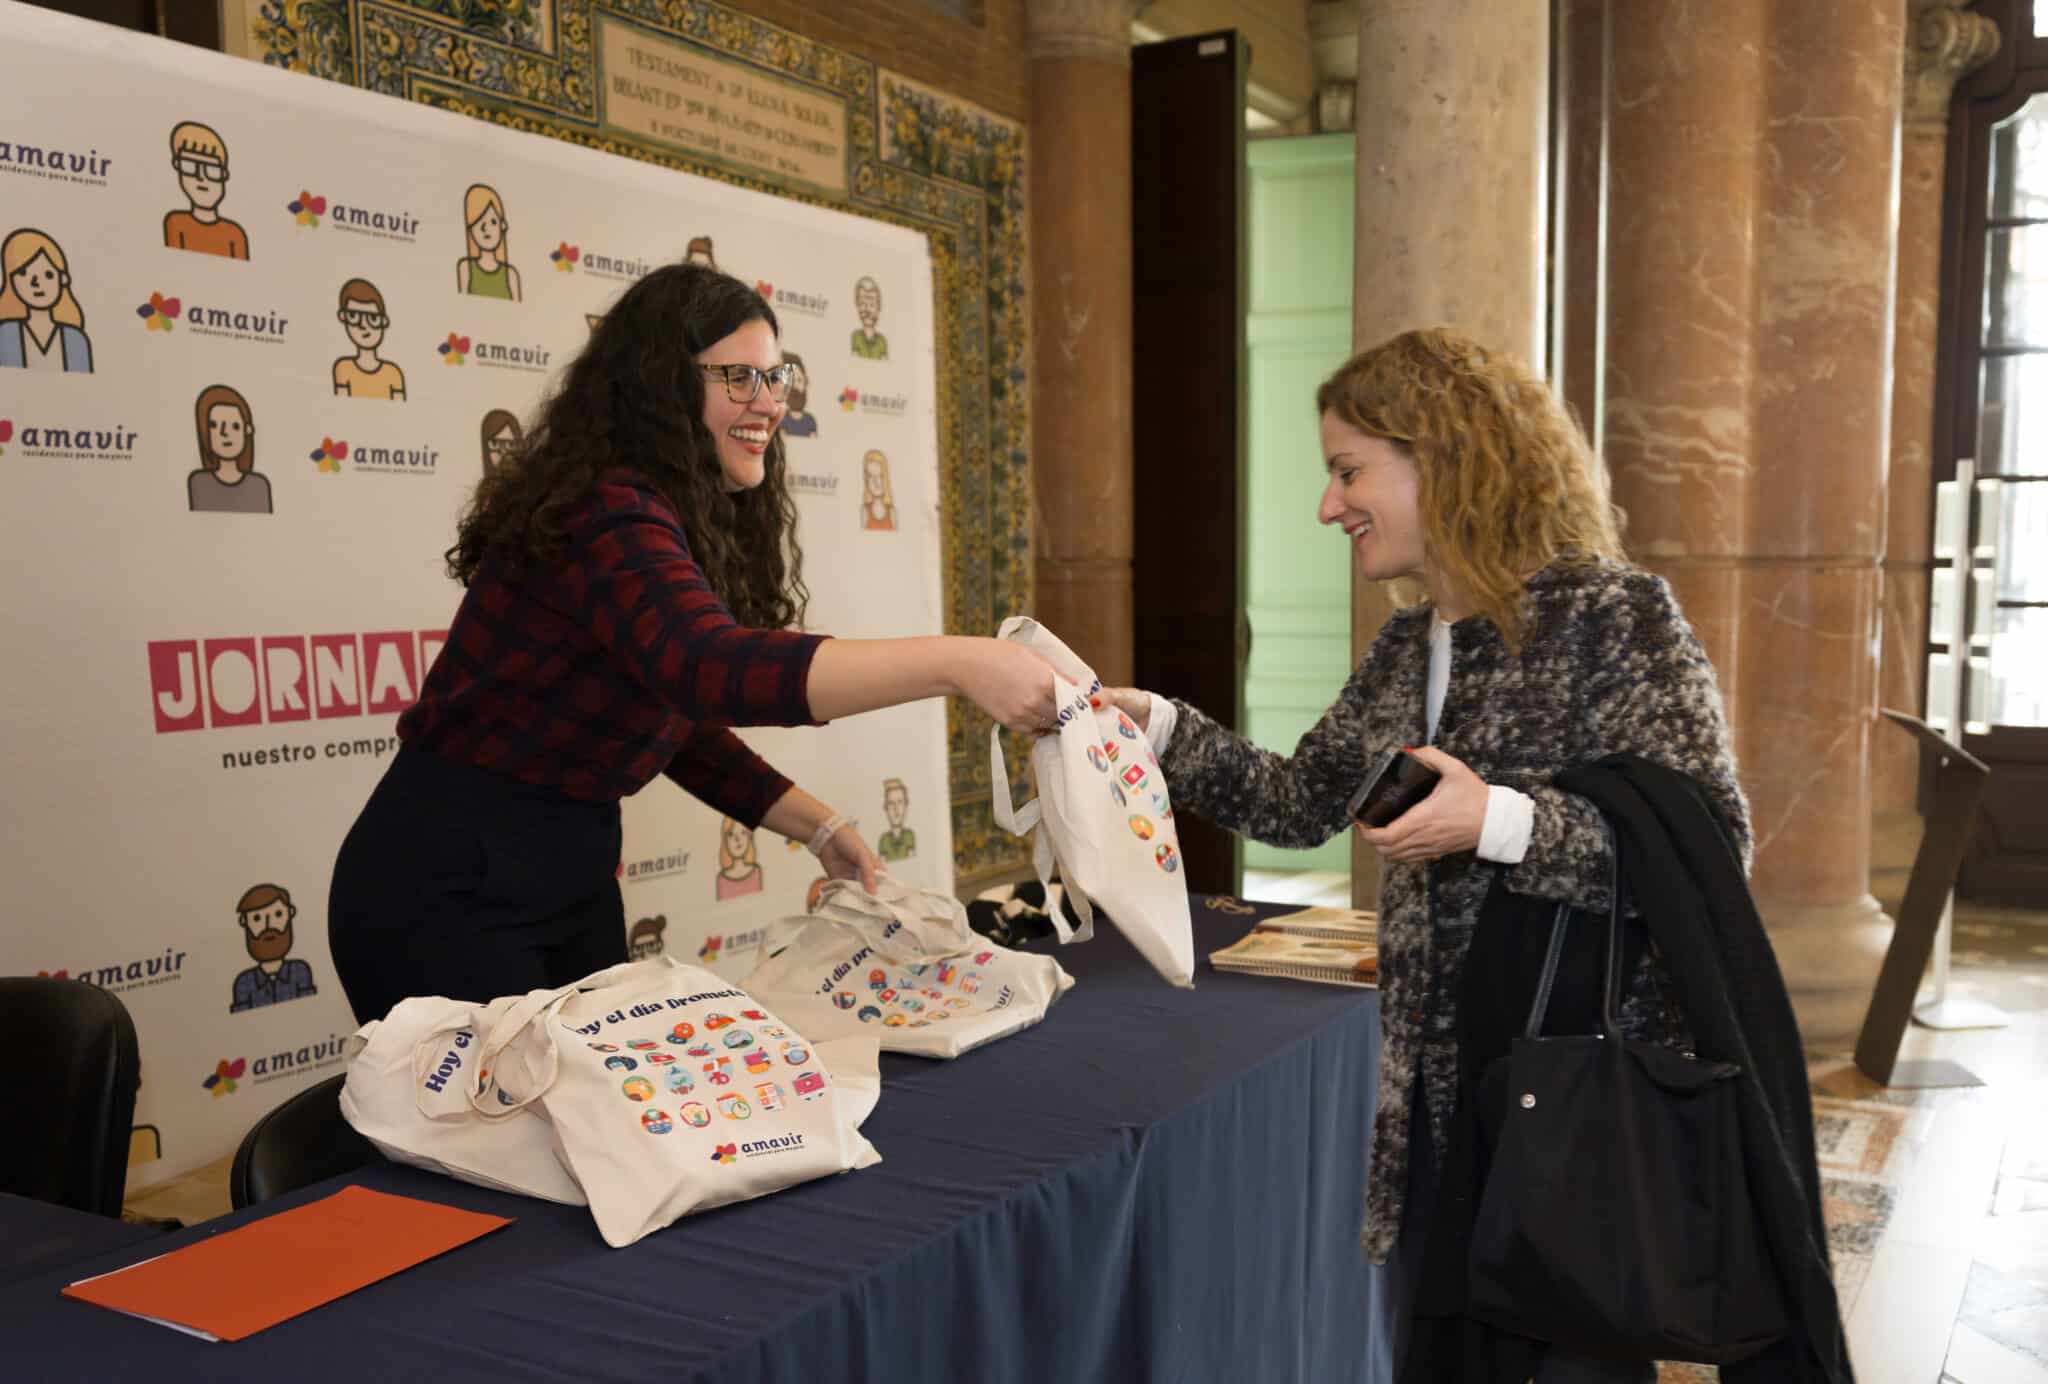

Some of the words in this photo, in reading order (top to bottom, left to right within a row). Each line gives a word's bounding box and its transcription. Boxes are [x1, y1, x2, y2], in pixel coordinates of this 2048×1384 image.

[0, 142, 112, 176] amavir
[332, 205, 419, 235] amavir
[584, 254, 651, 276] amavir
[776, 288, 829, 312] amavir
[188, 306, 288, 335] amavir
[475, 343, 550, 366] amavir
[21, 424, 138, 451] amavir
[354, 444, 439, 467] amavir
[222, 743, 317, 769] nuestro
[626, 848, 691, 877] amavir
[78, 947, 186, 986] amavir
[606, 1009, 627, 1025] el
[253, 1033, 348, 1075] amavir
[424, 1050, 462, 1093] Hoy
[454, 1031, 474, 1049] el
[741, 1132, 803, 1153] amavir
